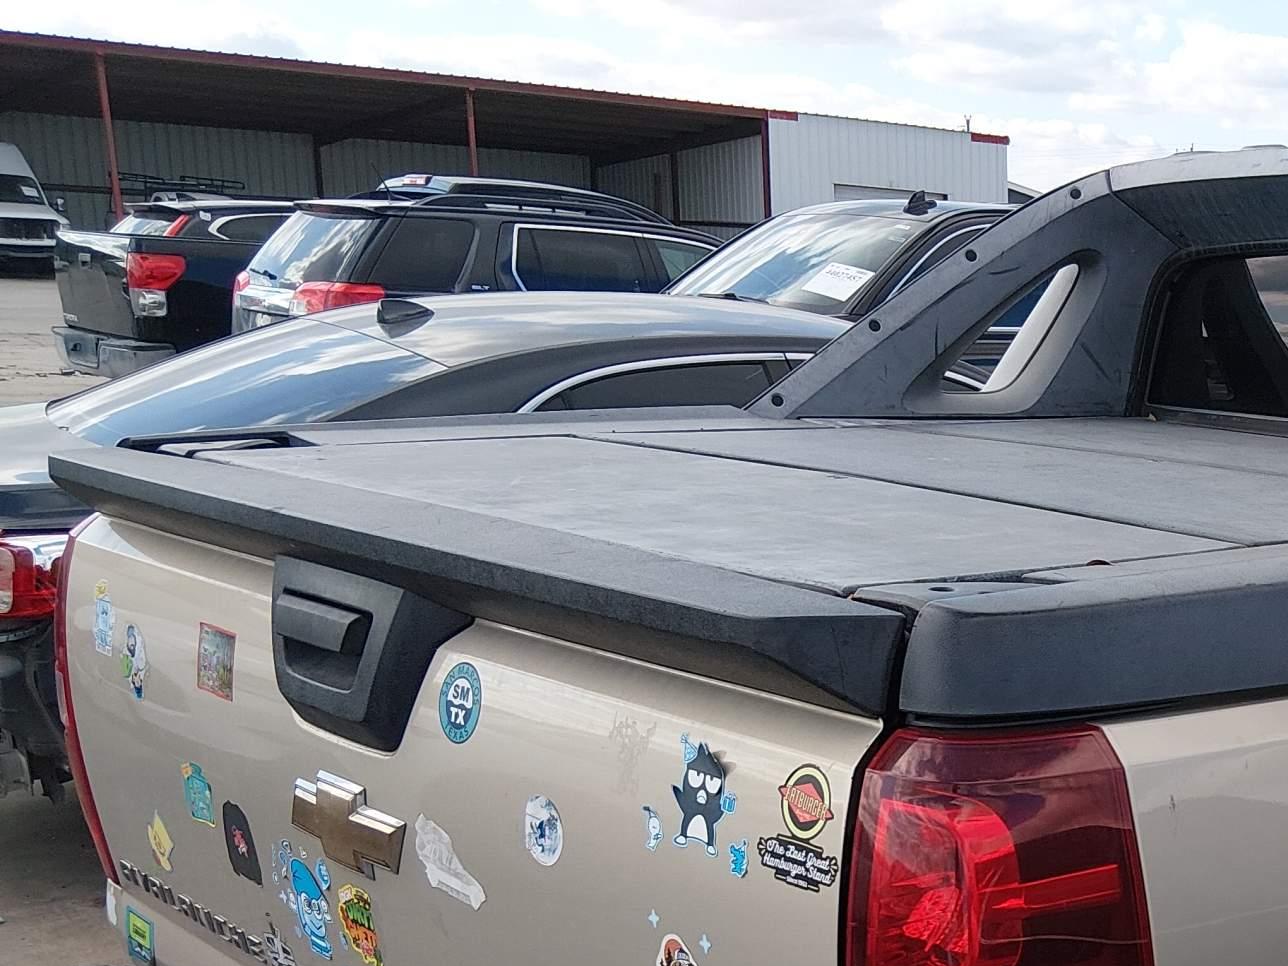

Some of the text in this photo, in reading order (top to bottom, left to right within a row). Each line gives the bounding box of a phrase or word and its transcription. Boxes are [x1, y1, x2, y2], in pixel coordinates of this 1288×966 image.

[441, 665, 480, 705] SAN MARCOS
[452, 684, 470, 703] SM
[450, 706, 466, 725] TX
[444, 724, 469, 740] TEXAS
[785, 785, 827, 821] FATBURGER
[763, 853, 832, 884] Hamburger Stand
[766, 839, 830, 871] The Last Great
